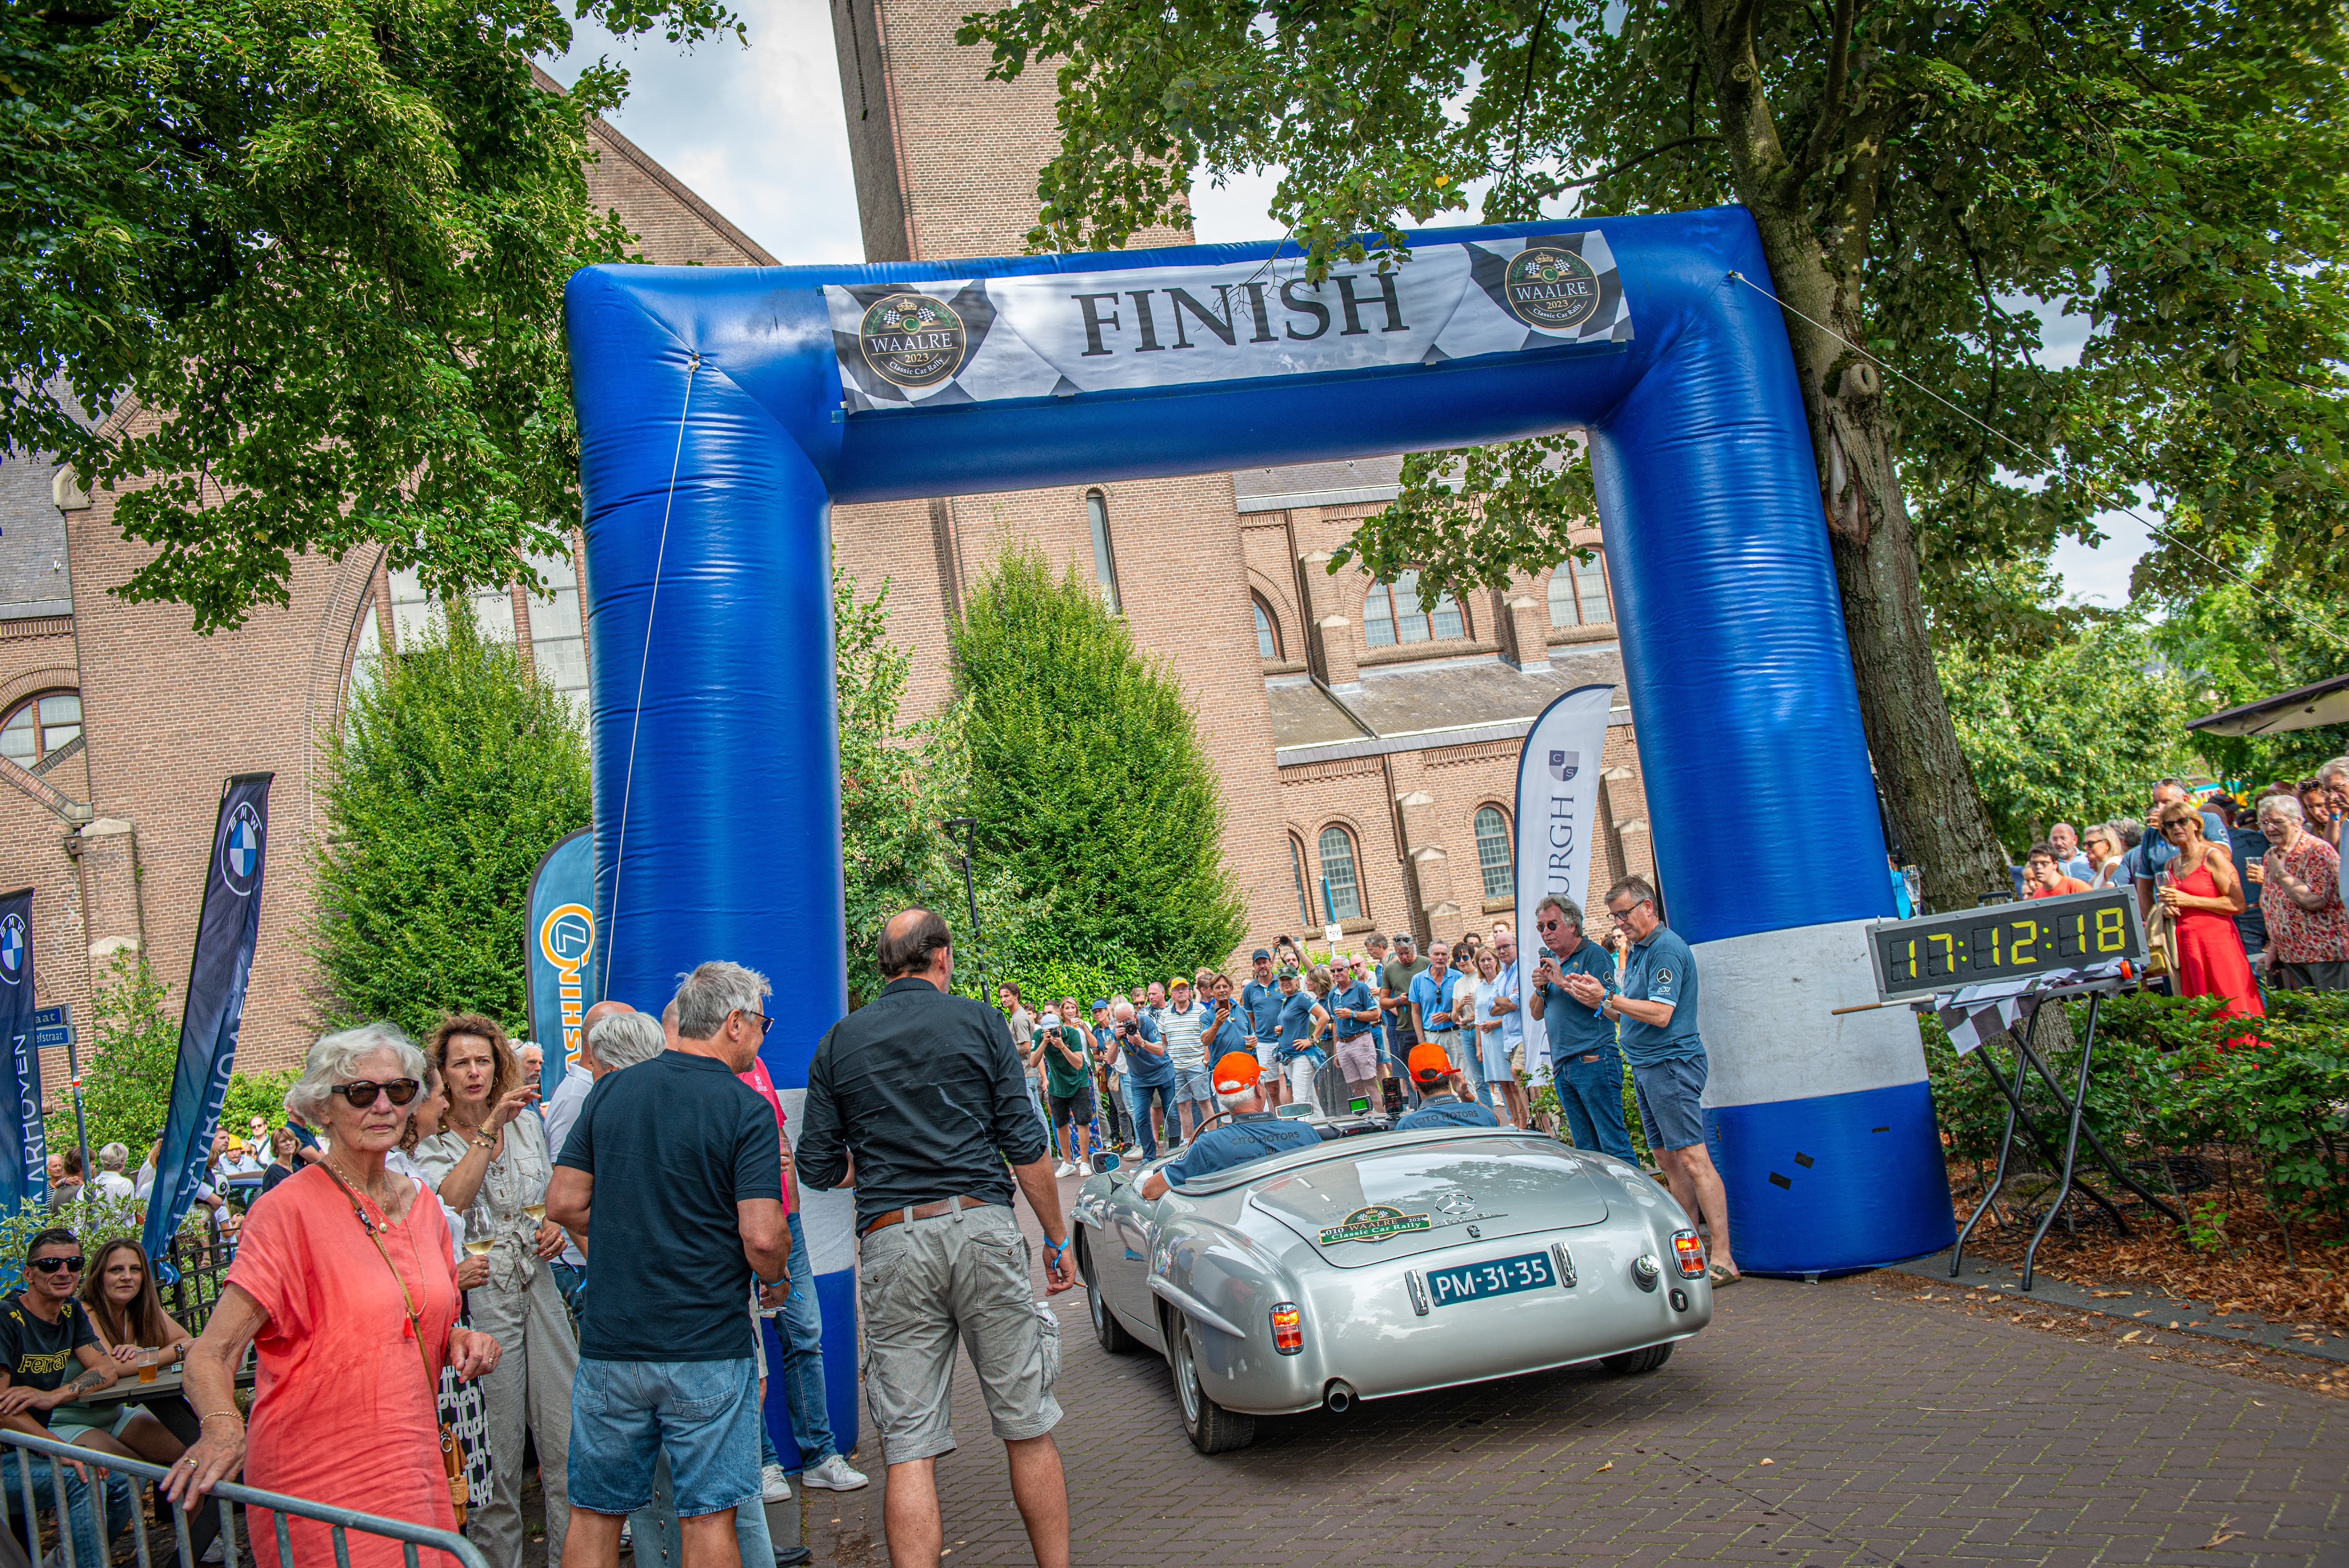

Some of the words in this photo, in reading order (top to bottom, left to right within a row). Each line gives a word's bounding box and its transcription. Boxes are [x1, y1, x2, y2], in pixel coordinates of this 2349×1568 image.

[1516, 282, 1588, 300] WAALRE
[1533, 308, 1555, 319] Classic
[1567, 303, 1583, 316] Rally
[1546, 300, 1568, 309] 2023
[1071, 272, 1410, 356] FINISH
[871, 333, 952, 353] WAALRE
[890, 362, 913, 375] Classic
[928, 357, 944, 372] Rally
[904, 353, 929, 363] 2023
[230, 807, 258, 832] BMW
[0, 917, 24, 938] BMW
[1909, 907, 2125, 978] 17:12:18
[1441, 1110, 1478, 1120] MOTORS
[1258, 1131, 1300, 1143] MOTORS
[1349, 1219, 1398, 1231] WAALRE
[1331, 1230, 1368, 1239] Classic
[1436, 1259, 1547, 1300] PM-31-35
